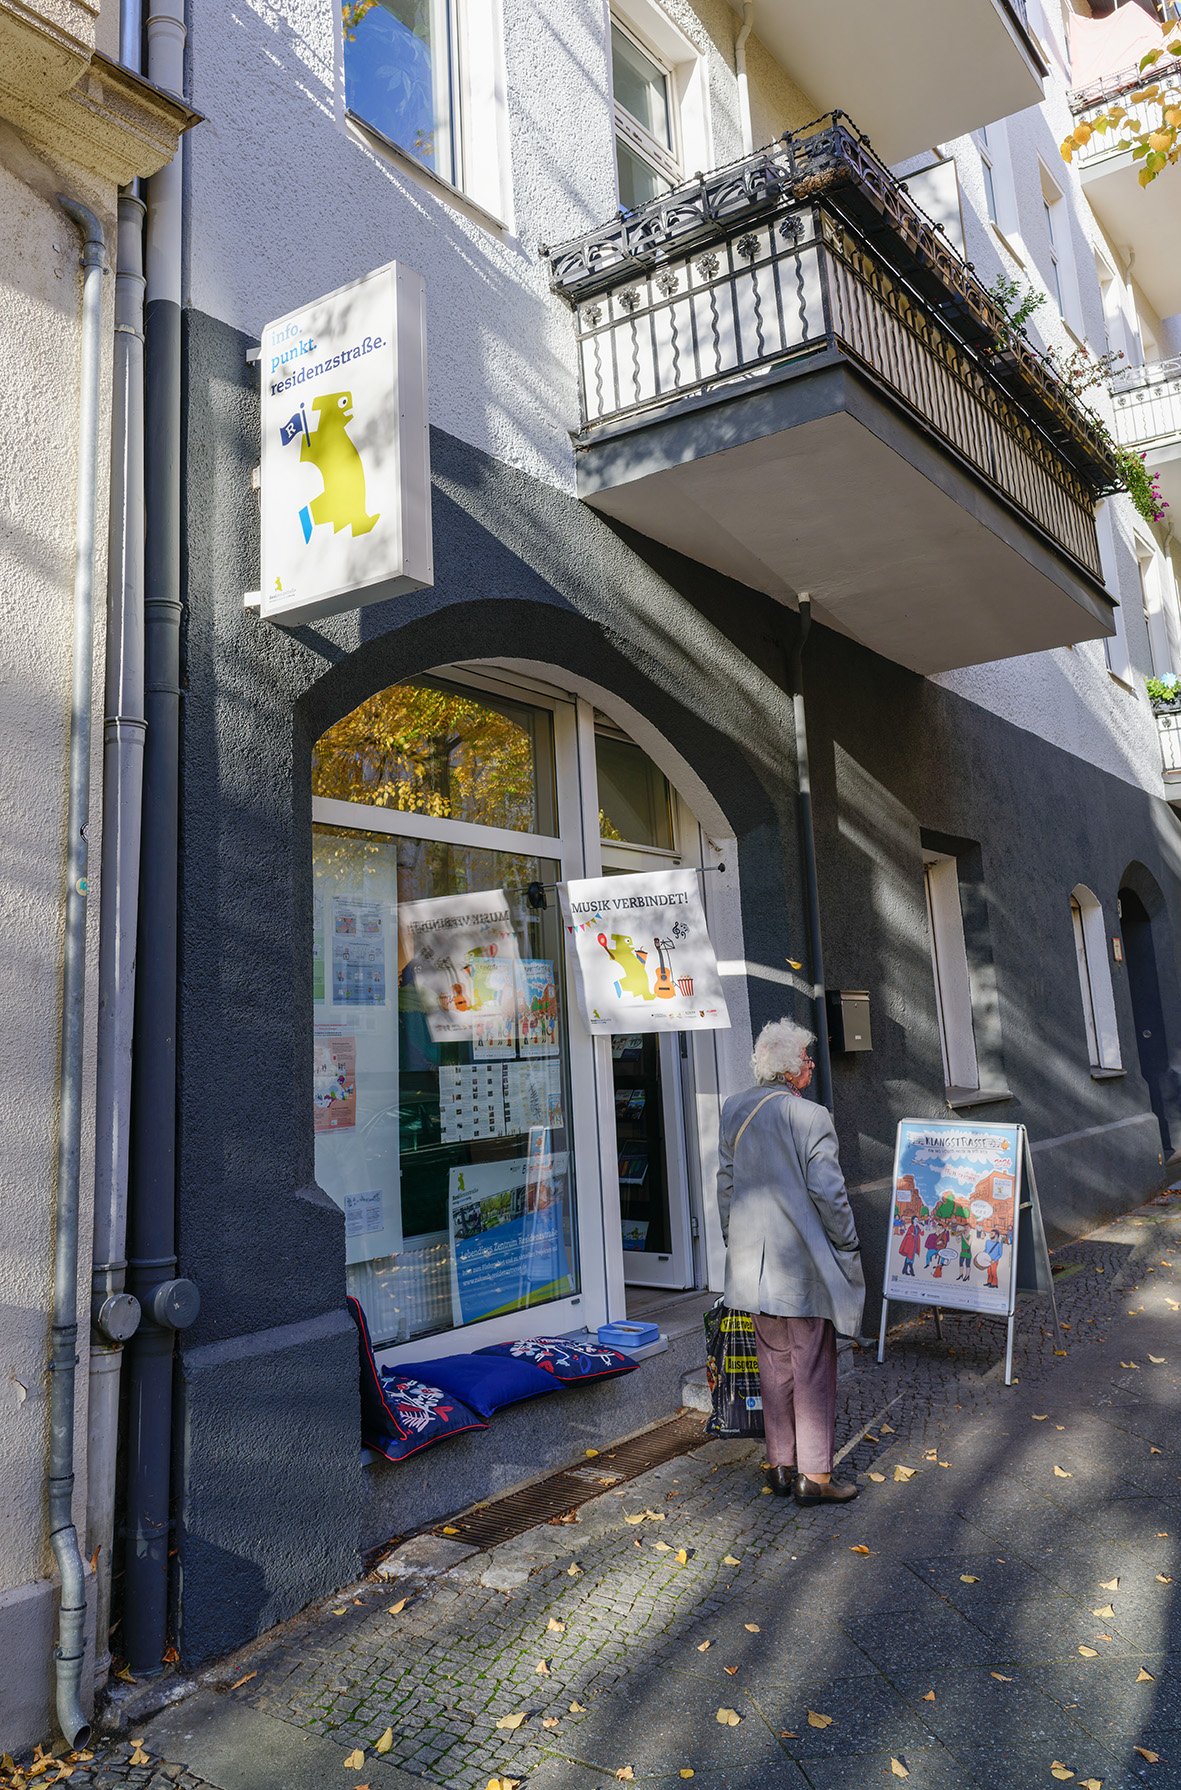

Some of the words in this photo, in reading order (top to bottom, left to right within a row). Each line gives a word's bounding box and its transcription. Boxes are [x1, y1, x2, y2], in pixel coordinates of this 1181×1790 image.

[272, 323, 302, 346] info.
[271, 338, 317, 373] punkt.
[271, 336, 386, 396] residenzstraße.
[285, 421, 297, 438] R
[571, 899, 611, 913] MUSIK
[612, 892, 688, 909] VERBINDET!
[925, 1137, 987, 1148] KLANGSTRASSE
